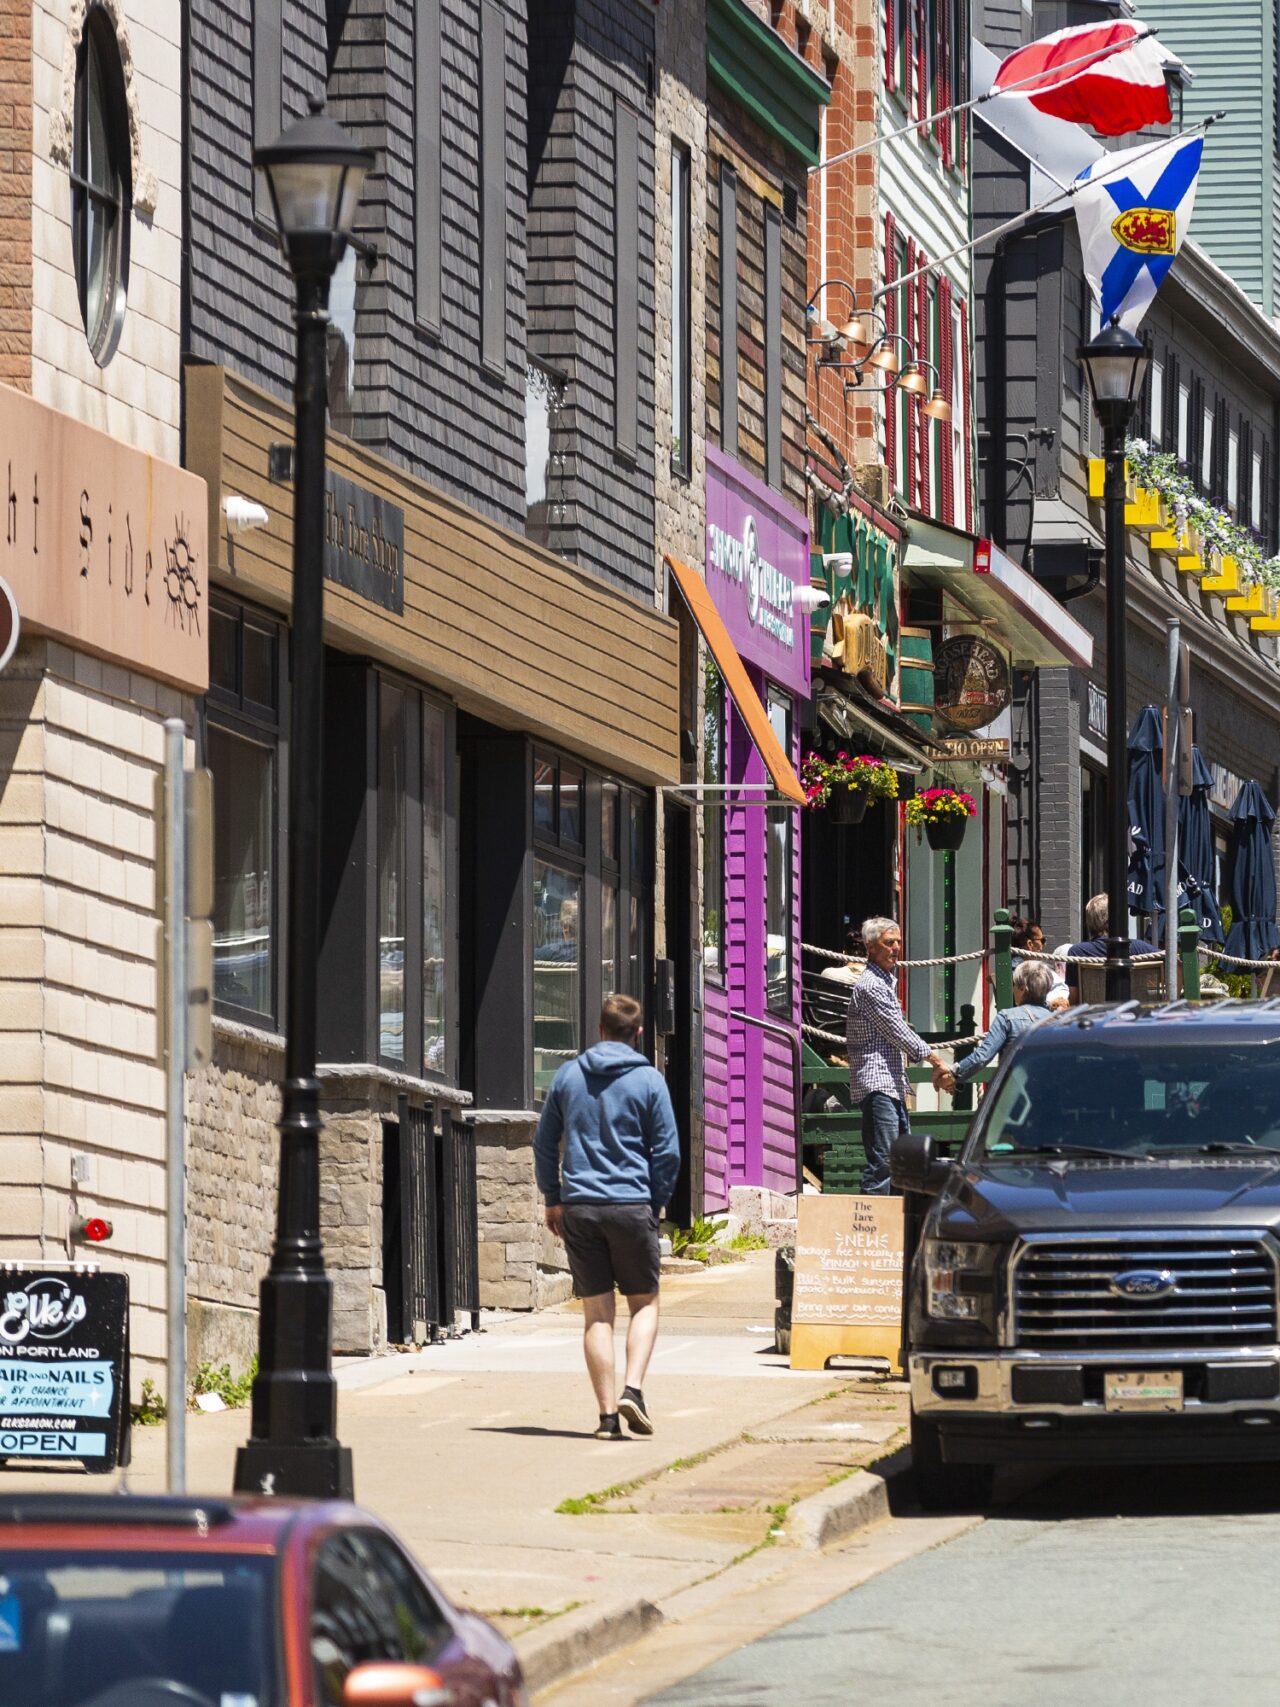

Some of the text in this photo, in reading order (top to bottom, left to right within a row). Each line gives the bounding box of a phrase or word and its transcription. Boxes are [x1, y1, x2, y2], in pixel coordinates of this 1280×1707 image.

[79, 489, 153, 606] Side
[372, 516, 398, 593] Shop
[935, 641, 1000, 682] MOOSEHEAD
[970, 740, 1004, 756] OPEN
[854, 1201, 872, 1211] The
[854, 1212, 874, 1222] Tare
[852, 1223, 877, 1234] Shop
[845, 1234, 879, 1248] NEW
[797, 1302, 823, 1315] Bring
[826, 1304, 848, 1314] your
[0, 1287, 87, 1345] Elk's
[16, 1346, 100, 1359] PORTLAND
[0, 1369, 28, 1382] AIR
[48, 1370, 105, 1384] NAILS
[11, 1386, 70, 1396] BY CHANCE
[11, 1398, 85, 1408] APPOINTMENT
[1, 1434, 77, 1451] OPEN
